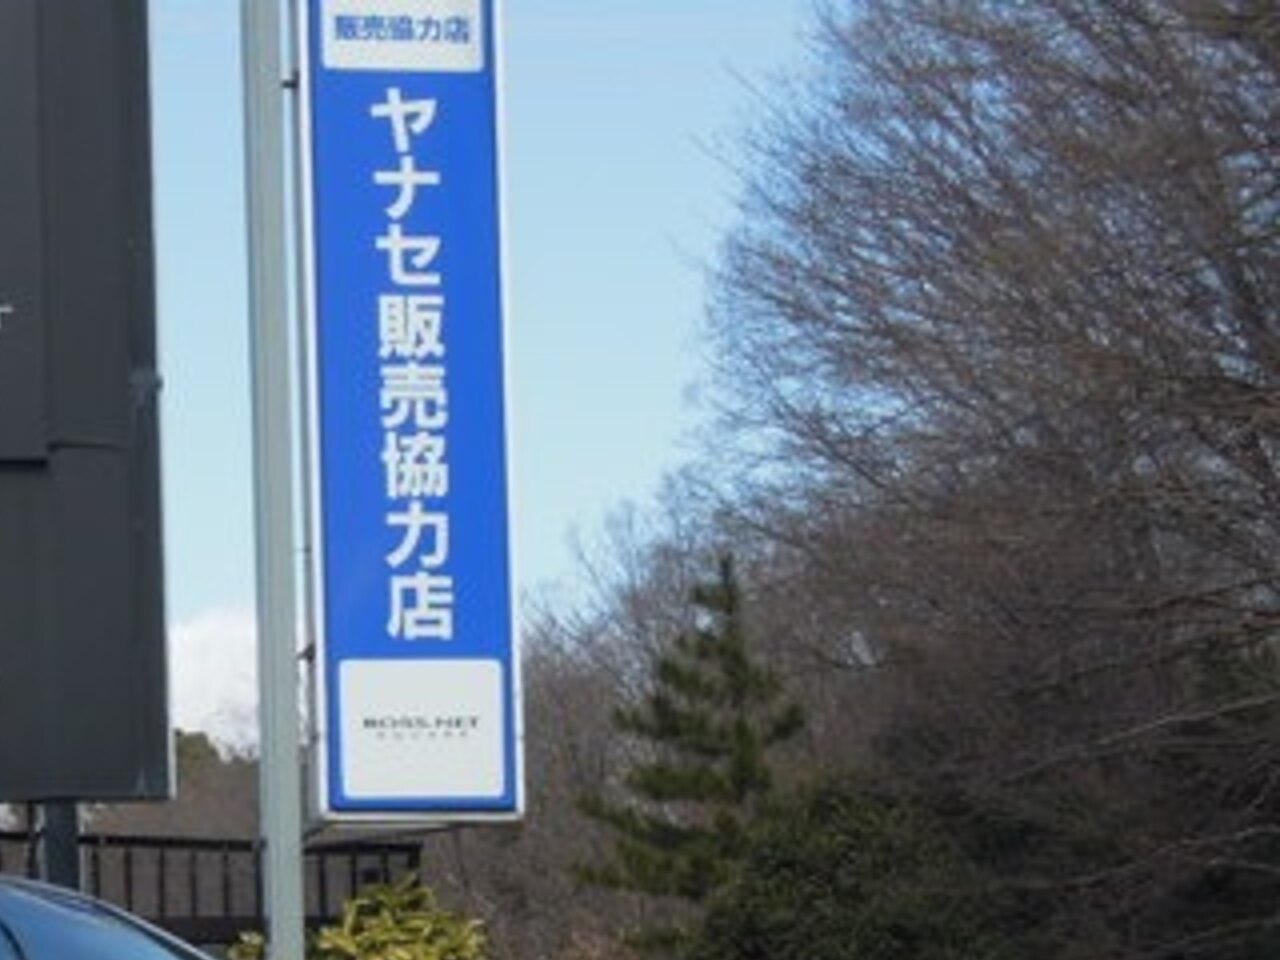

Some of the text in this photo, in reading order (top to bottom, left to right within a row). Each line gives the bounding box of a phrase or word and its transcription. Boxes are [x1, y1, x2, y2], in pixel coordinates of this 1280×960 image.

[334, 14, 470, 43] 販売協力店
[370, 86, 455, 642] ヤナセ販売協力店
